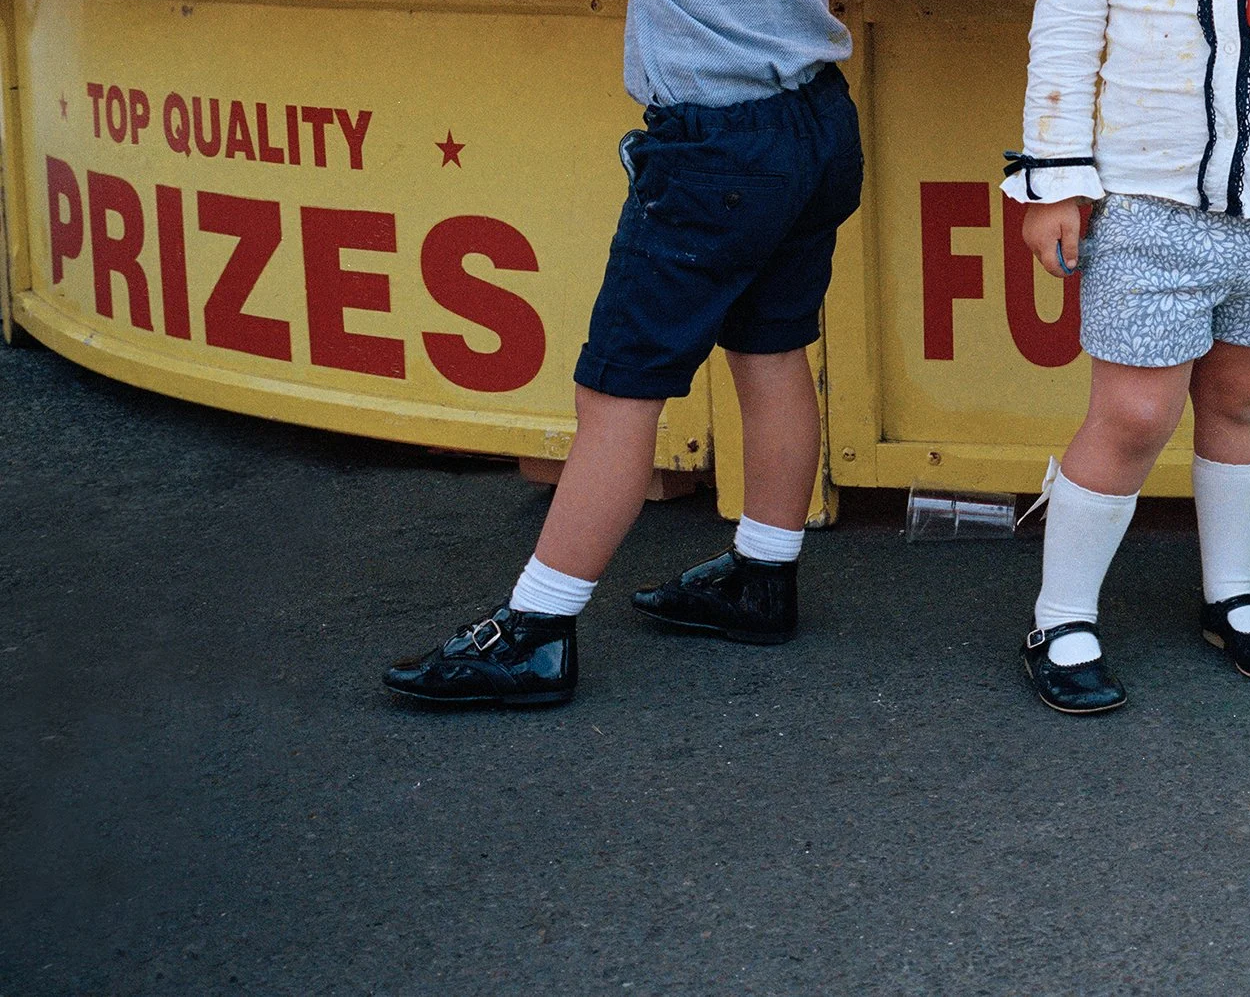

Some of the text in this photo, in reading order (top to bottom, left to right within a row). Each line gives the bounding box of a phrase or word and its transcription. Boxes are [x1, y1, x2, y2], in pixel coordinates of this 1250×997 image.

[87, 82, 373, 170] TOP QUALITY
[46, 155, 547, 393] PRIZES
